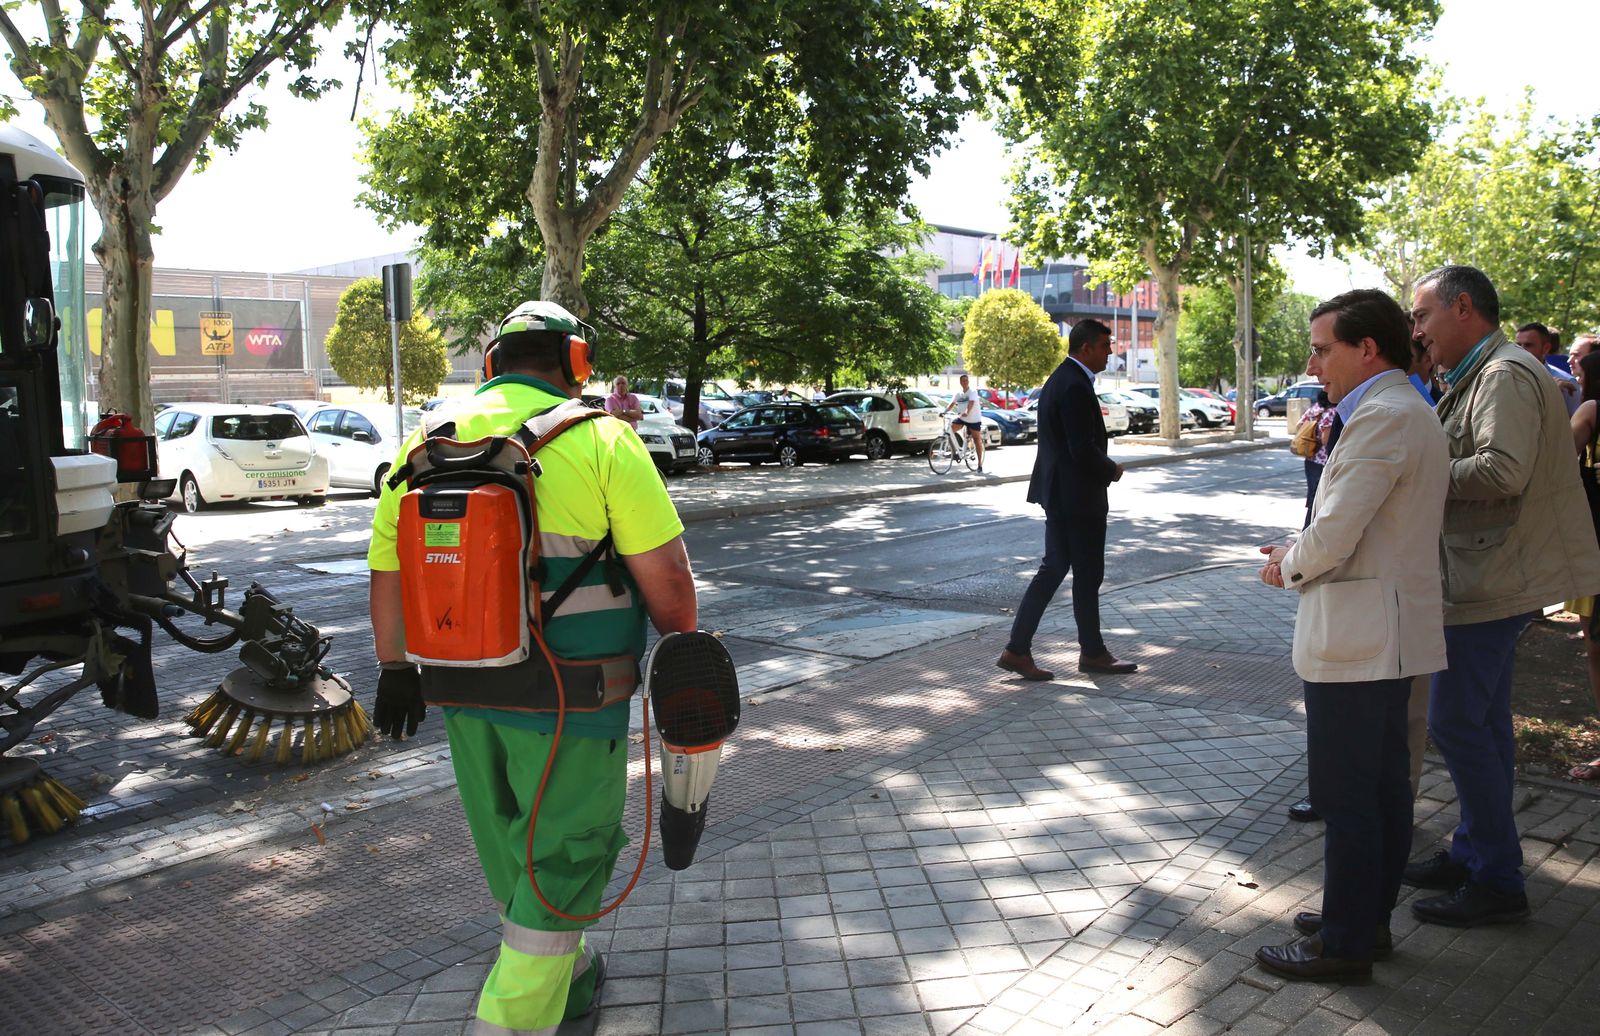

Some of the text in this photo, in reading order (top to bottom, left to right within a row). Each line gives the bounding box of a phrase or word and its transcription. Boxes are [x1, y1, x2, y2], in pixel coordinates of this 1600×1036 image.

[248, 334, 283, 346] WTA
[205, 342, 232, 351] ATP
[266, 470, 307, 478] emisiones
[263, 480, 280, 488] 5351
[425, 553, 461, 564] STIHL
